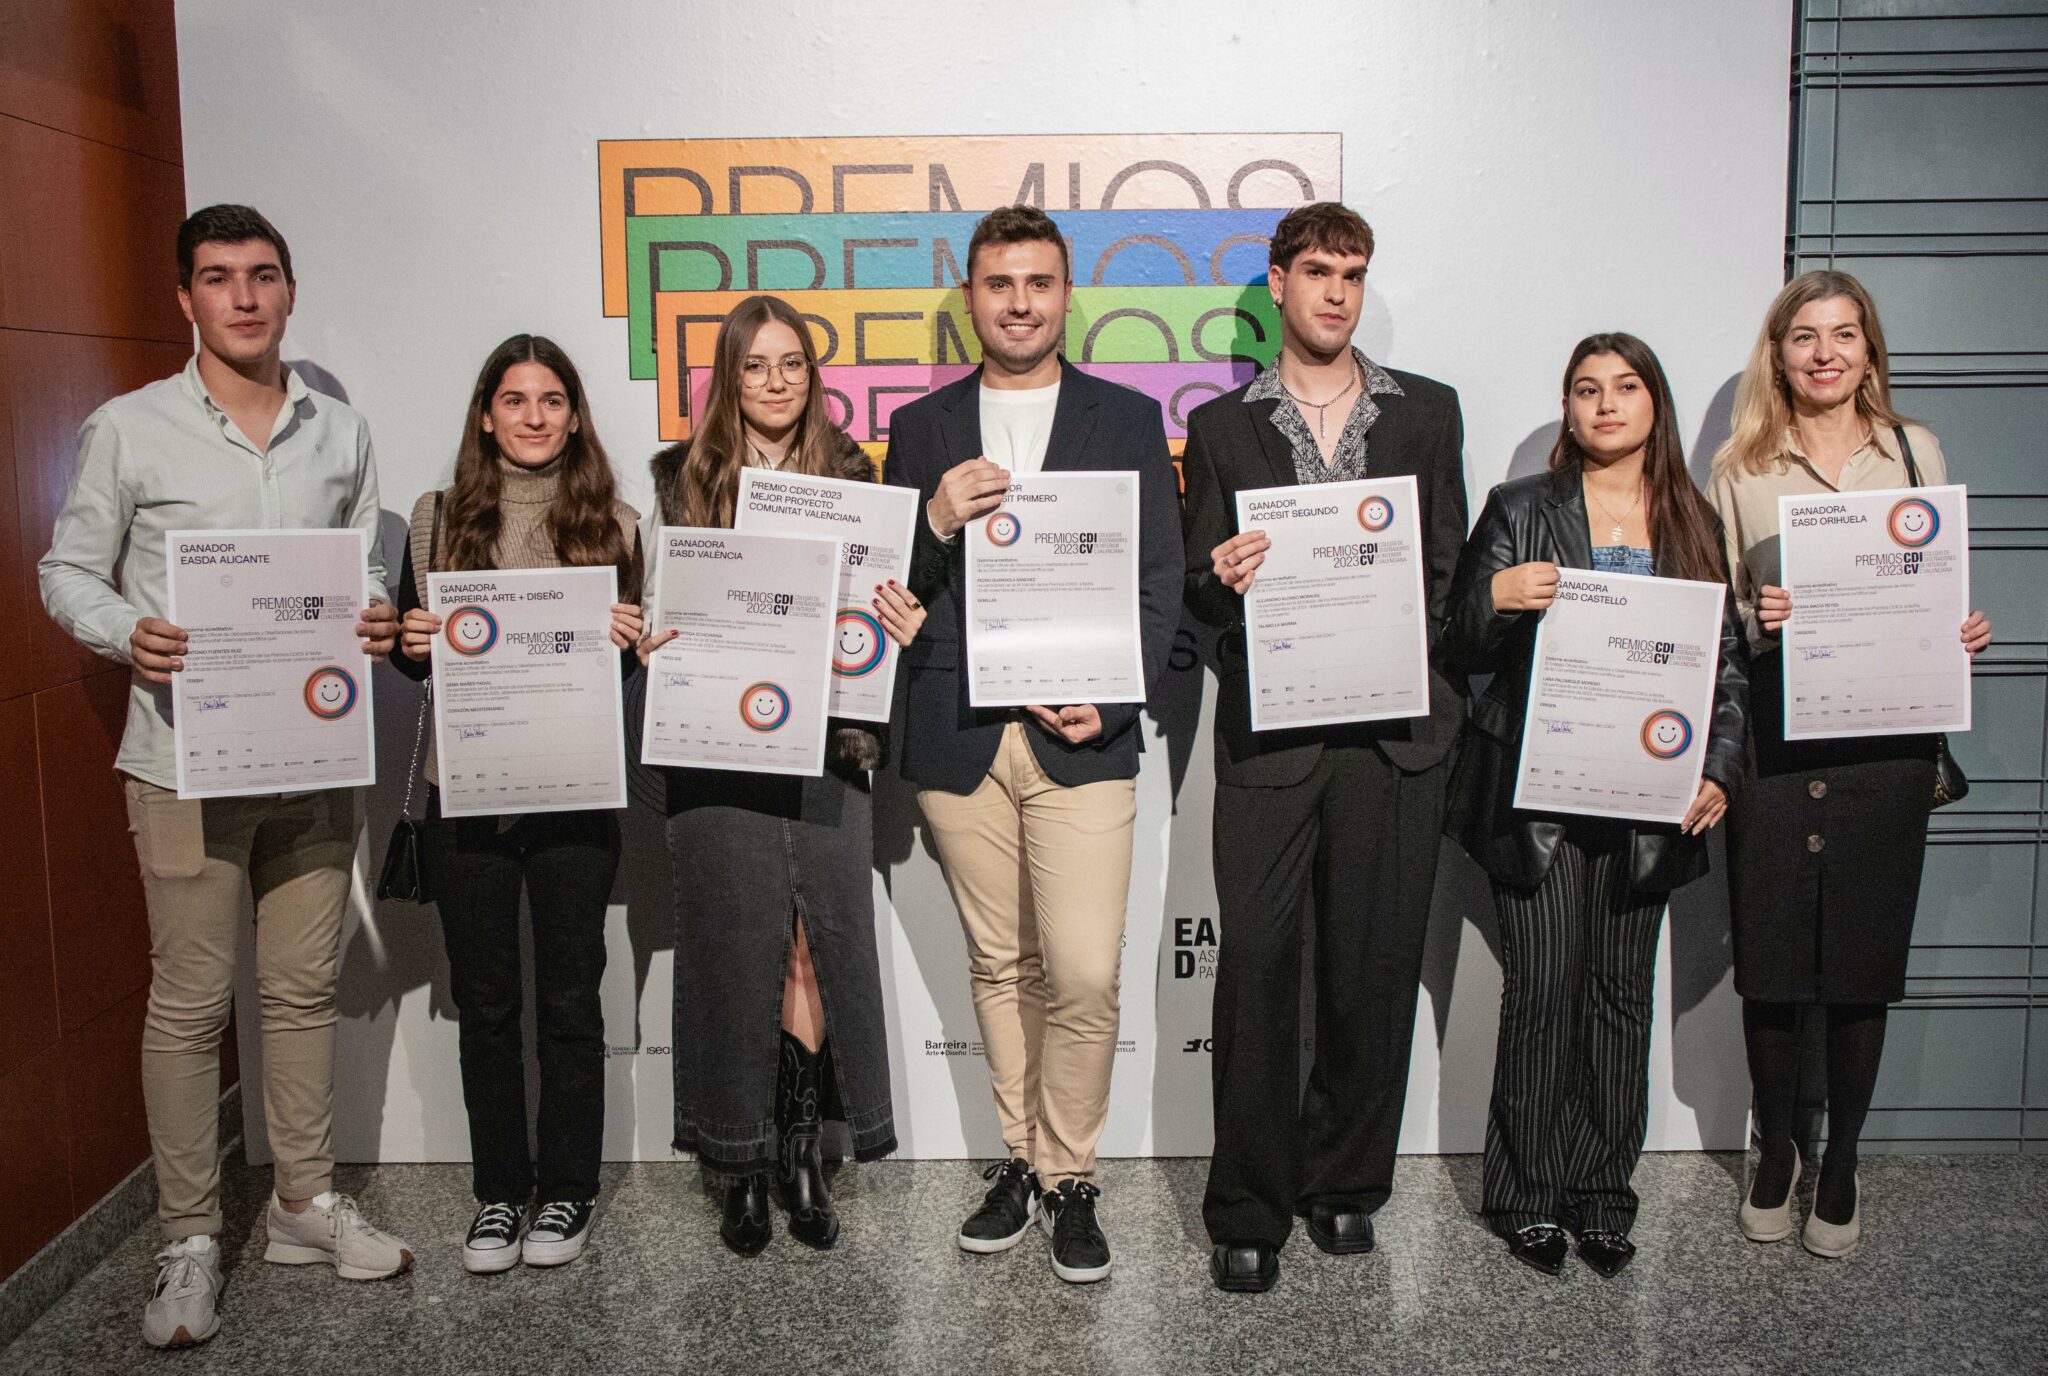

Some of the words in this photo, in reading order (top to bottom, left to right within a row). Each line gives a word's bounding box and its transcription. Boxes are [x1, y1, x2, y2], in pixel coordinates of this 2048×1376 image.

[751, 480, 787, 494] PREMIO
[789, 485, 819, 497] CDICV
[820, 490, 842, 500] 2023
[750, 491, 783, 503] MEJOR
[784, 496, 834, 510] PROYECTO
[1017, 494, 1058, 503] PRIMERO
[1248, 499, 1297, 511] GANADOR
[749, 502, 803, 516] COMUNITAT
[804, 509, 861, 524] VALENCIANA
[1291, 506, 1339, 518] SEGUNDO
[1791, 505, 1846, 517] GANADORA
[1791, 518, 1817, 527] EASD
[1819, 515, 1868, 526] ORIHUELA
[670, 539, 725, 549] GANADORA
[1034, 533, 1079, 544] PREMIOS
[1079, 532, 1097, 543] CDI
[180, 543, 235, 553] GANADOR
[669, 549, 695, 558] EASD
[850, 543, 869, 556] CDI
[1054, 543, 1079, 555] 2023
[1079, 543, 1093, 554] CV
[1313, 544, 1359, 559] PREMIOS
[1359, 542, 1378, 554] CDI
[180, 555, 217, 565] EASDA
[219, 554, 270, 564] ALICANTE
[848, 554, 863, 566] CV
[1333, 556, 1359, 569] 2023
[1360, 554, 1374, 566] CV
[1855, 553, 1903, 567] PREMIOS
[1903, 552, 1923, 563] CDI
[1876, 564, 1903, 577] 2023
[1904, 563, 1919, 575] CV
[440, 583, 497, 593] GANADORA
[252, 597, 303, 610] PREMIOS
[304, 596, 324, 608] CDI
[441, 594, 489, 604] BARREIRA
[492, 593, 516, 602] ARTE
[526, 590, 564, 601] DISEÑO
[727, 590, 774, 603] PREMIOS
[774, 593, 793, 605] CDI
[275, 609, 303, 622] 2023
[304, 609, 320, 620] CV
[746, 602, 773, 615] 2023
[773, 604, 788, 616] CV
[506, 632, 554, 644] PREMIOS
[554, 631, 574, 642] CDI
[527, 643, 555, 655] 2023
[555, 642, 570, 653] CV
[1608, 636, 1655, 652] PREMIOS
[1655, 641, 1674, 654] CDI
[1626, 650, 1653, 663] 2023
[1653, 653, 1669, 665] CV
[925, 1040, 967, 1050] Barreira
